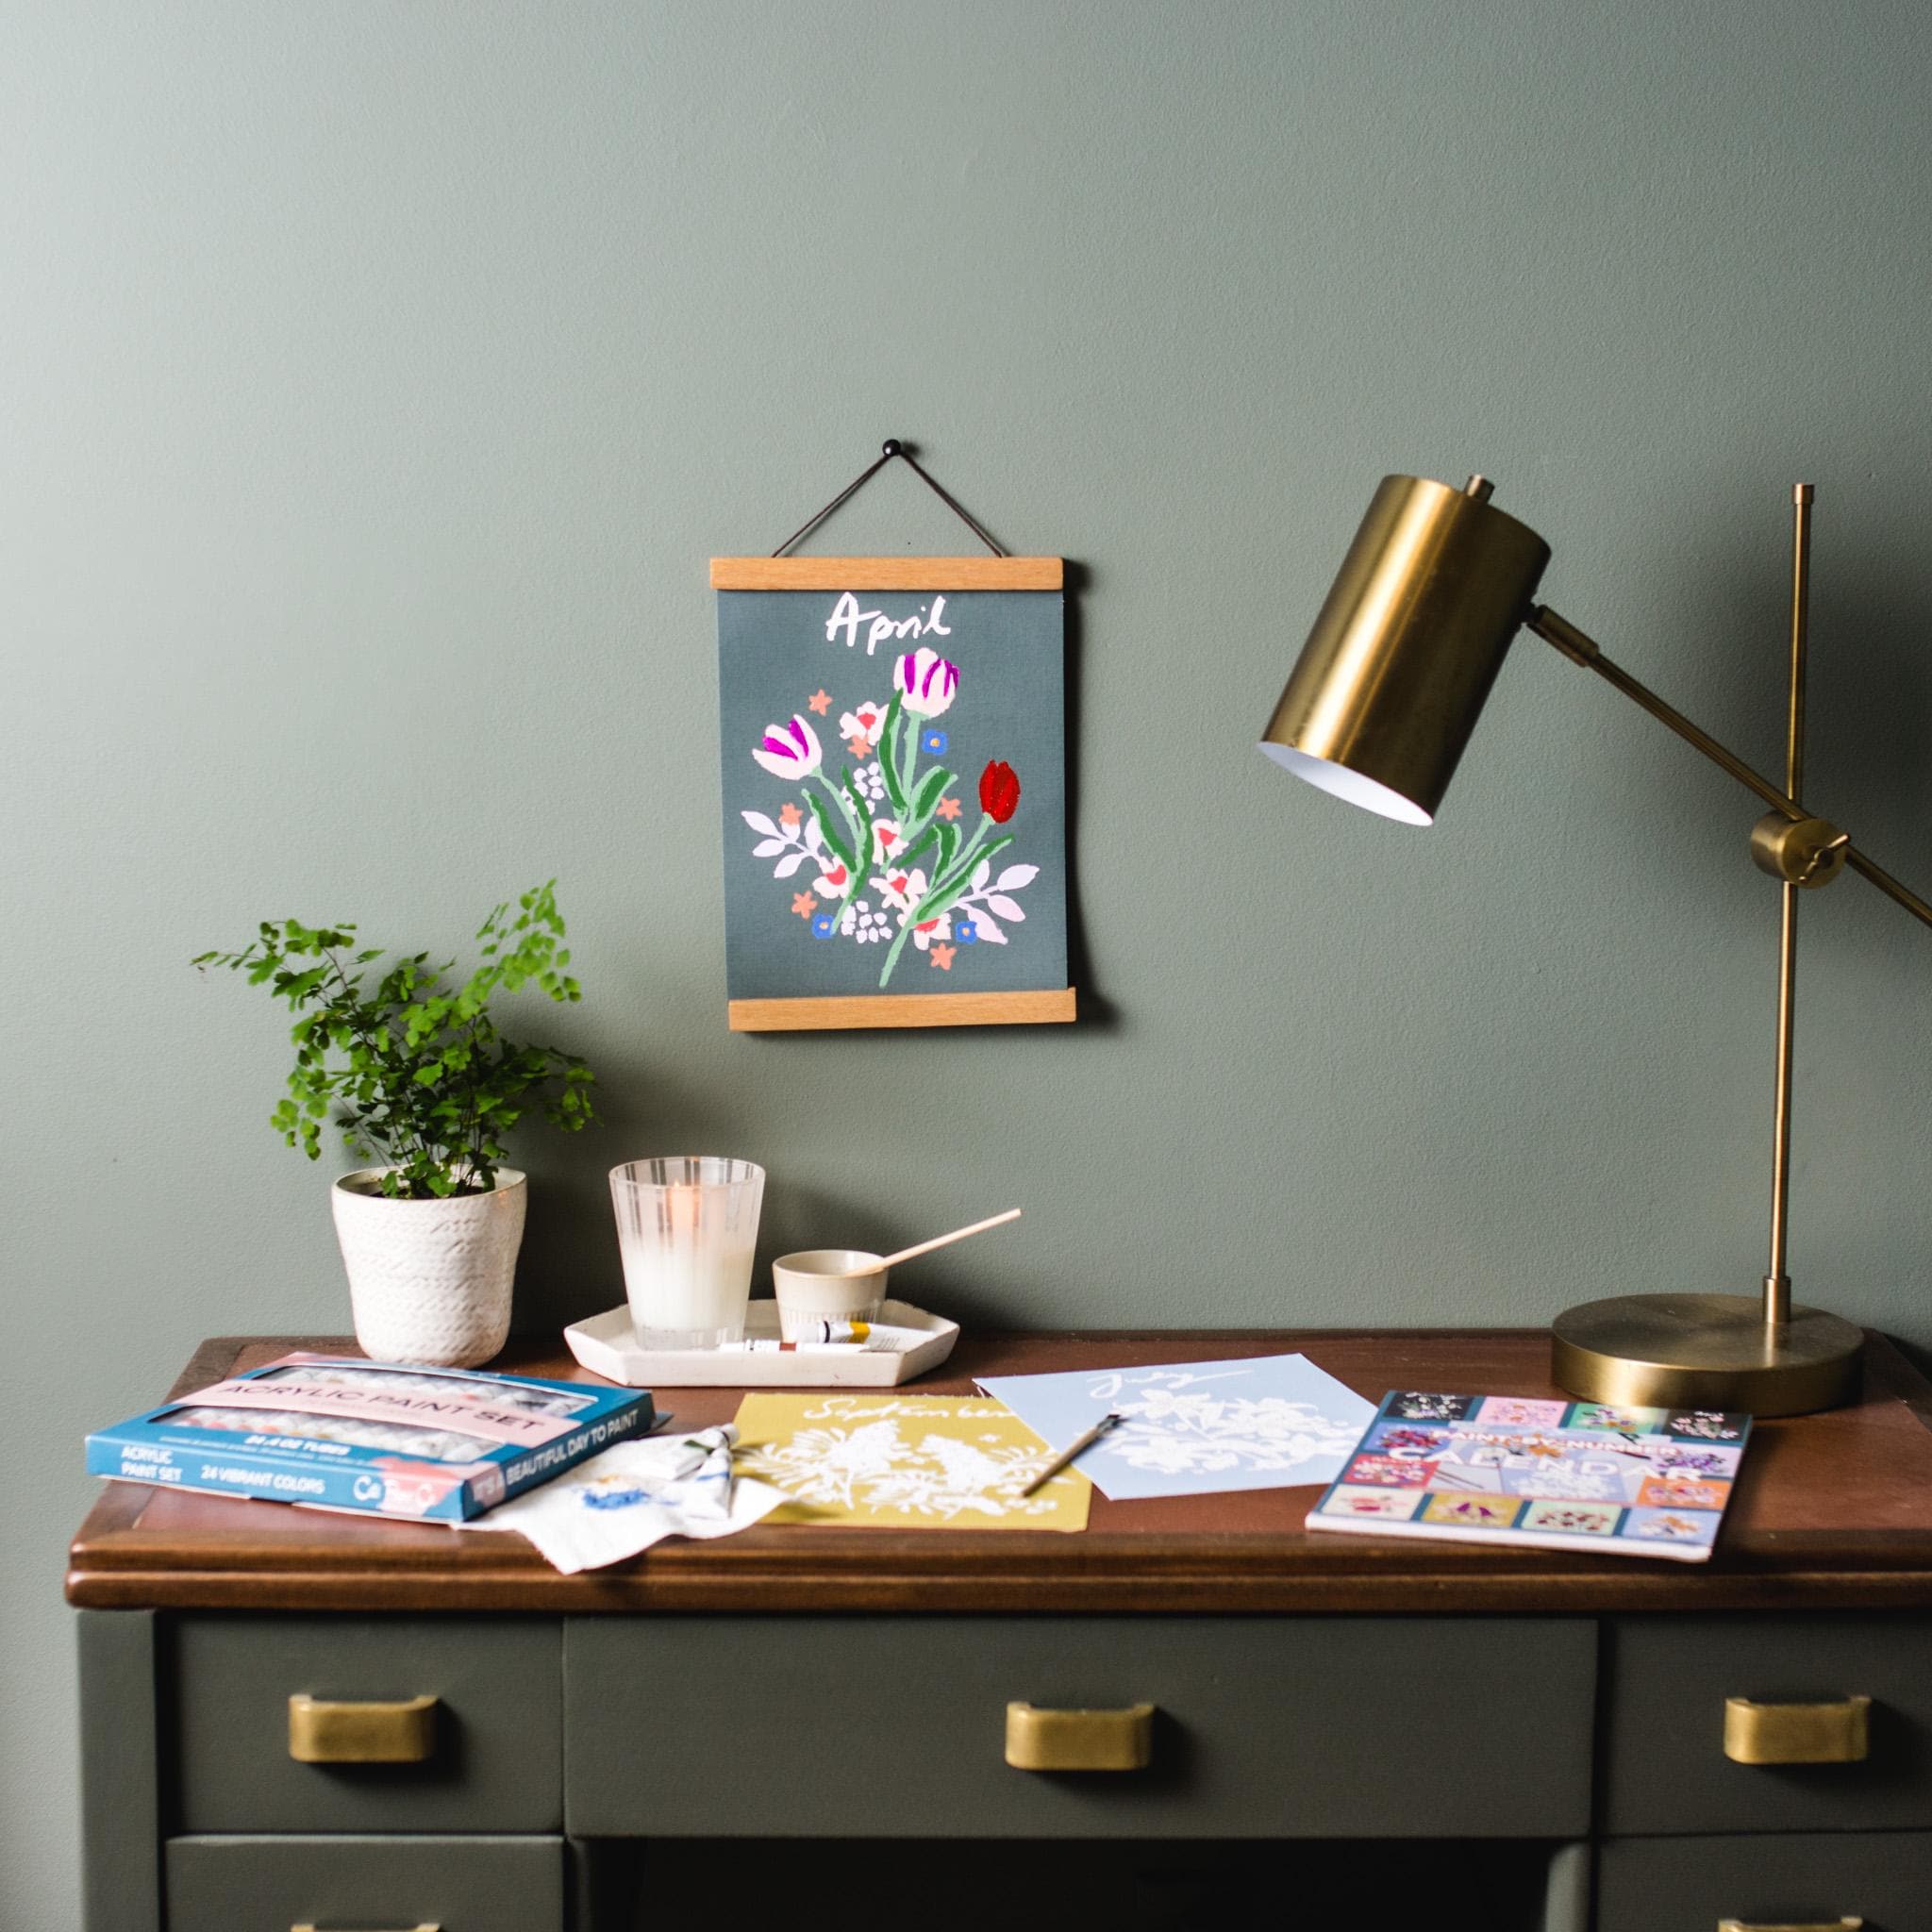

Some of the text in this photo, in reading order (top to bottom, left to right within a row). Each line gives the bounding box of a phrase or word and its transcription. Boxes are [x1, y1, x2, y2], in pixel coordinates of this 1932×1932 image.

[825, 591, 951, 655] April
[221, 1385, 365, 1401] ACRYLIC
[368, 1395, 474, 1414] PAINT
[474, 1410, 545, 1430] SET
[804, 1398, 1017, 1421] September
[121, 1445, 173, 1464] ACRYLIC
[506, 1442, 566, 1485] BEAUTIFUL
[568, 1432, 591, 1457] DAY
[591, 1424, 607, 1445] TO
[608, 1408, 640, 1438] PAINT
[1388, 1444, 1703, 1482] CALENDAR
[121, 1460, 183, 1482] PAINT SET
[200, 1463, 325, 1495] 24 VIBRANT COLORS
